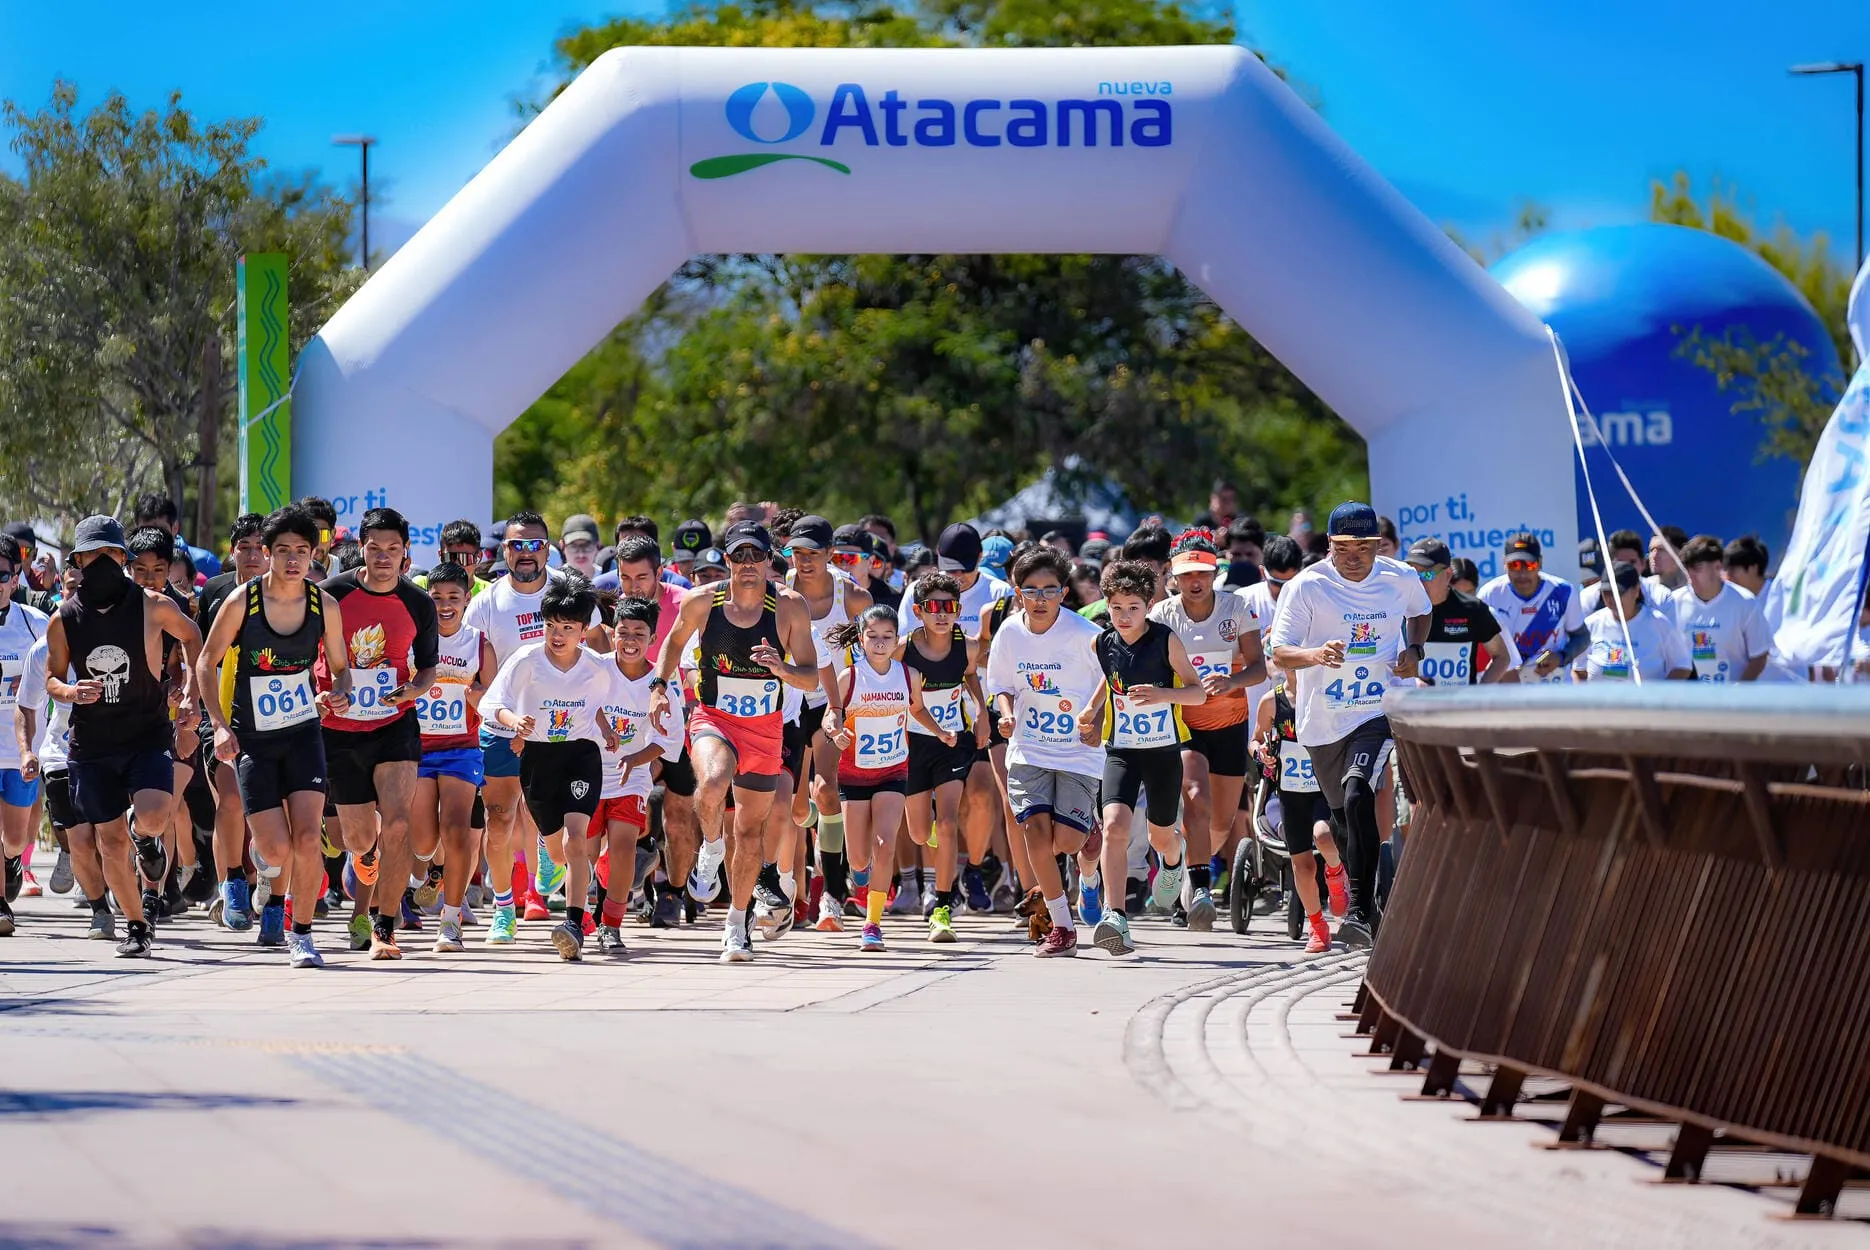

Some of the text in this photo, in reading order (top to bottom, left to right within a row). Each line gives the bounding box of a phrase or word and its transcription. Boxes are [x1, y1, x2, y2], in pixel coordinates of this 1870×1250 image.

[1098, 80, 1172, 95] nueva
[820, 83, 1173, 147] Atacama
[1398, 493, 1475, 533] por ti,
[1353, 611, 1387, 621] Atacama
[1026, 662, 1062, 671] Atacama
[1422, 658, 1468, 679] 006
[257, 683, 309, 717] 061
[416, 698, 463, 721] 260
[552, 698, 586, 708] Atacama
[722, 694, 772, 717] 381
[1026, 706, 1075, 735] 329
[1119, 709, 1168, 735] 267
[859, 727, 903, 754] 257
[1354, 752, 1370, 767] 10
[1070, 807, 1091, 825] FILA
